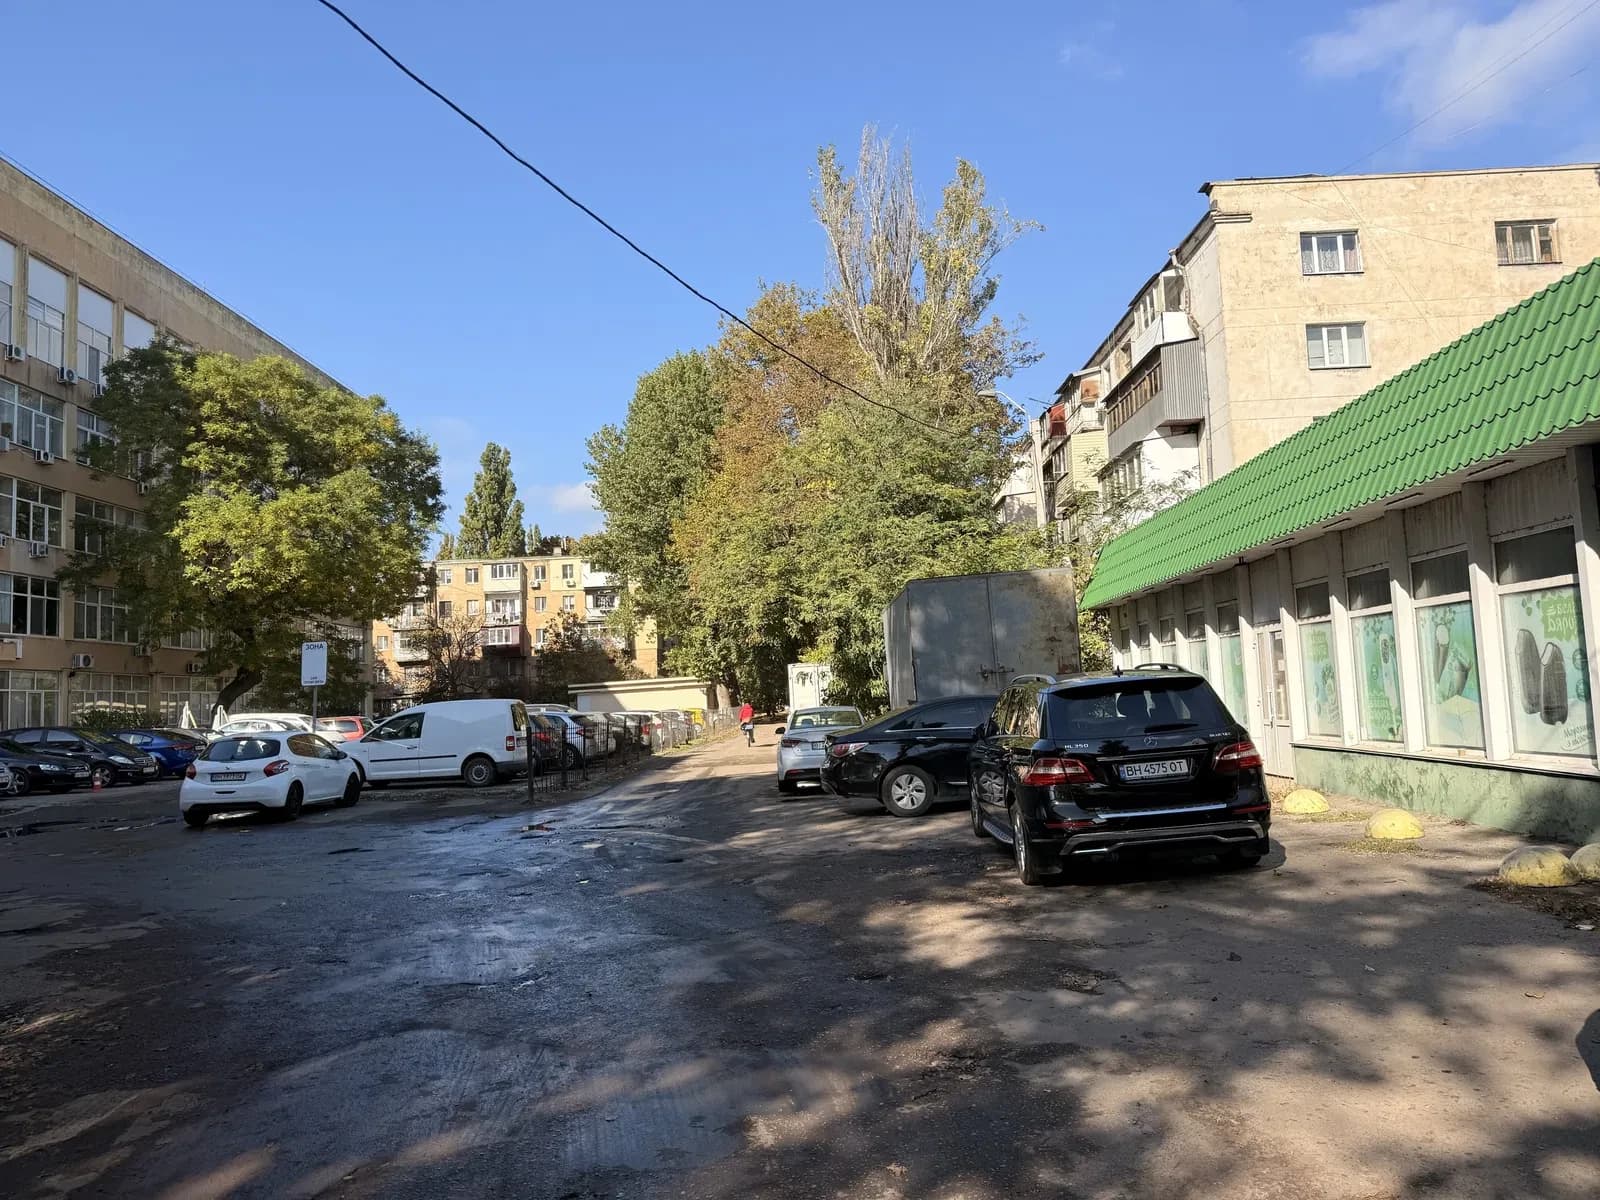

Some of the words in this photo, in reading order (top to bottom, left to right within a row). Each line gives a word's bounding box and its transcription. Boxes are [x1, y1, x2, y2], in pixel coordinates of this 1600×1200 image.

[1126, 765, 1142, 776] BH
[1144, 763, 1168, 774] 4575
[1169, 761, 1184, 772] OT
